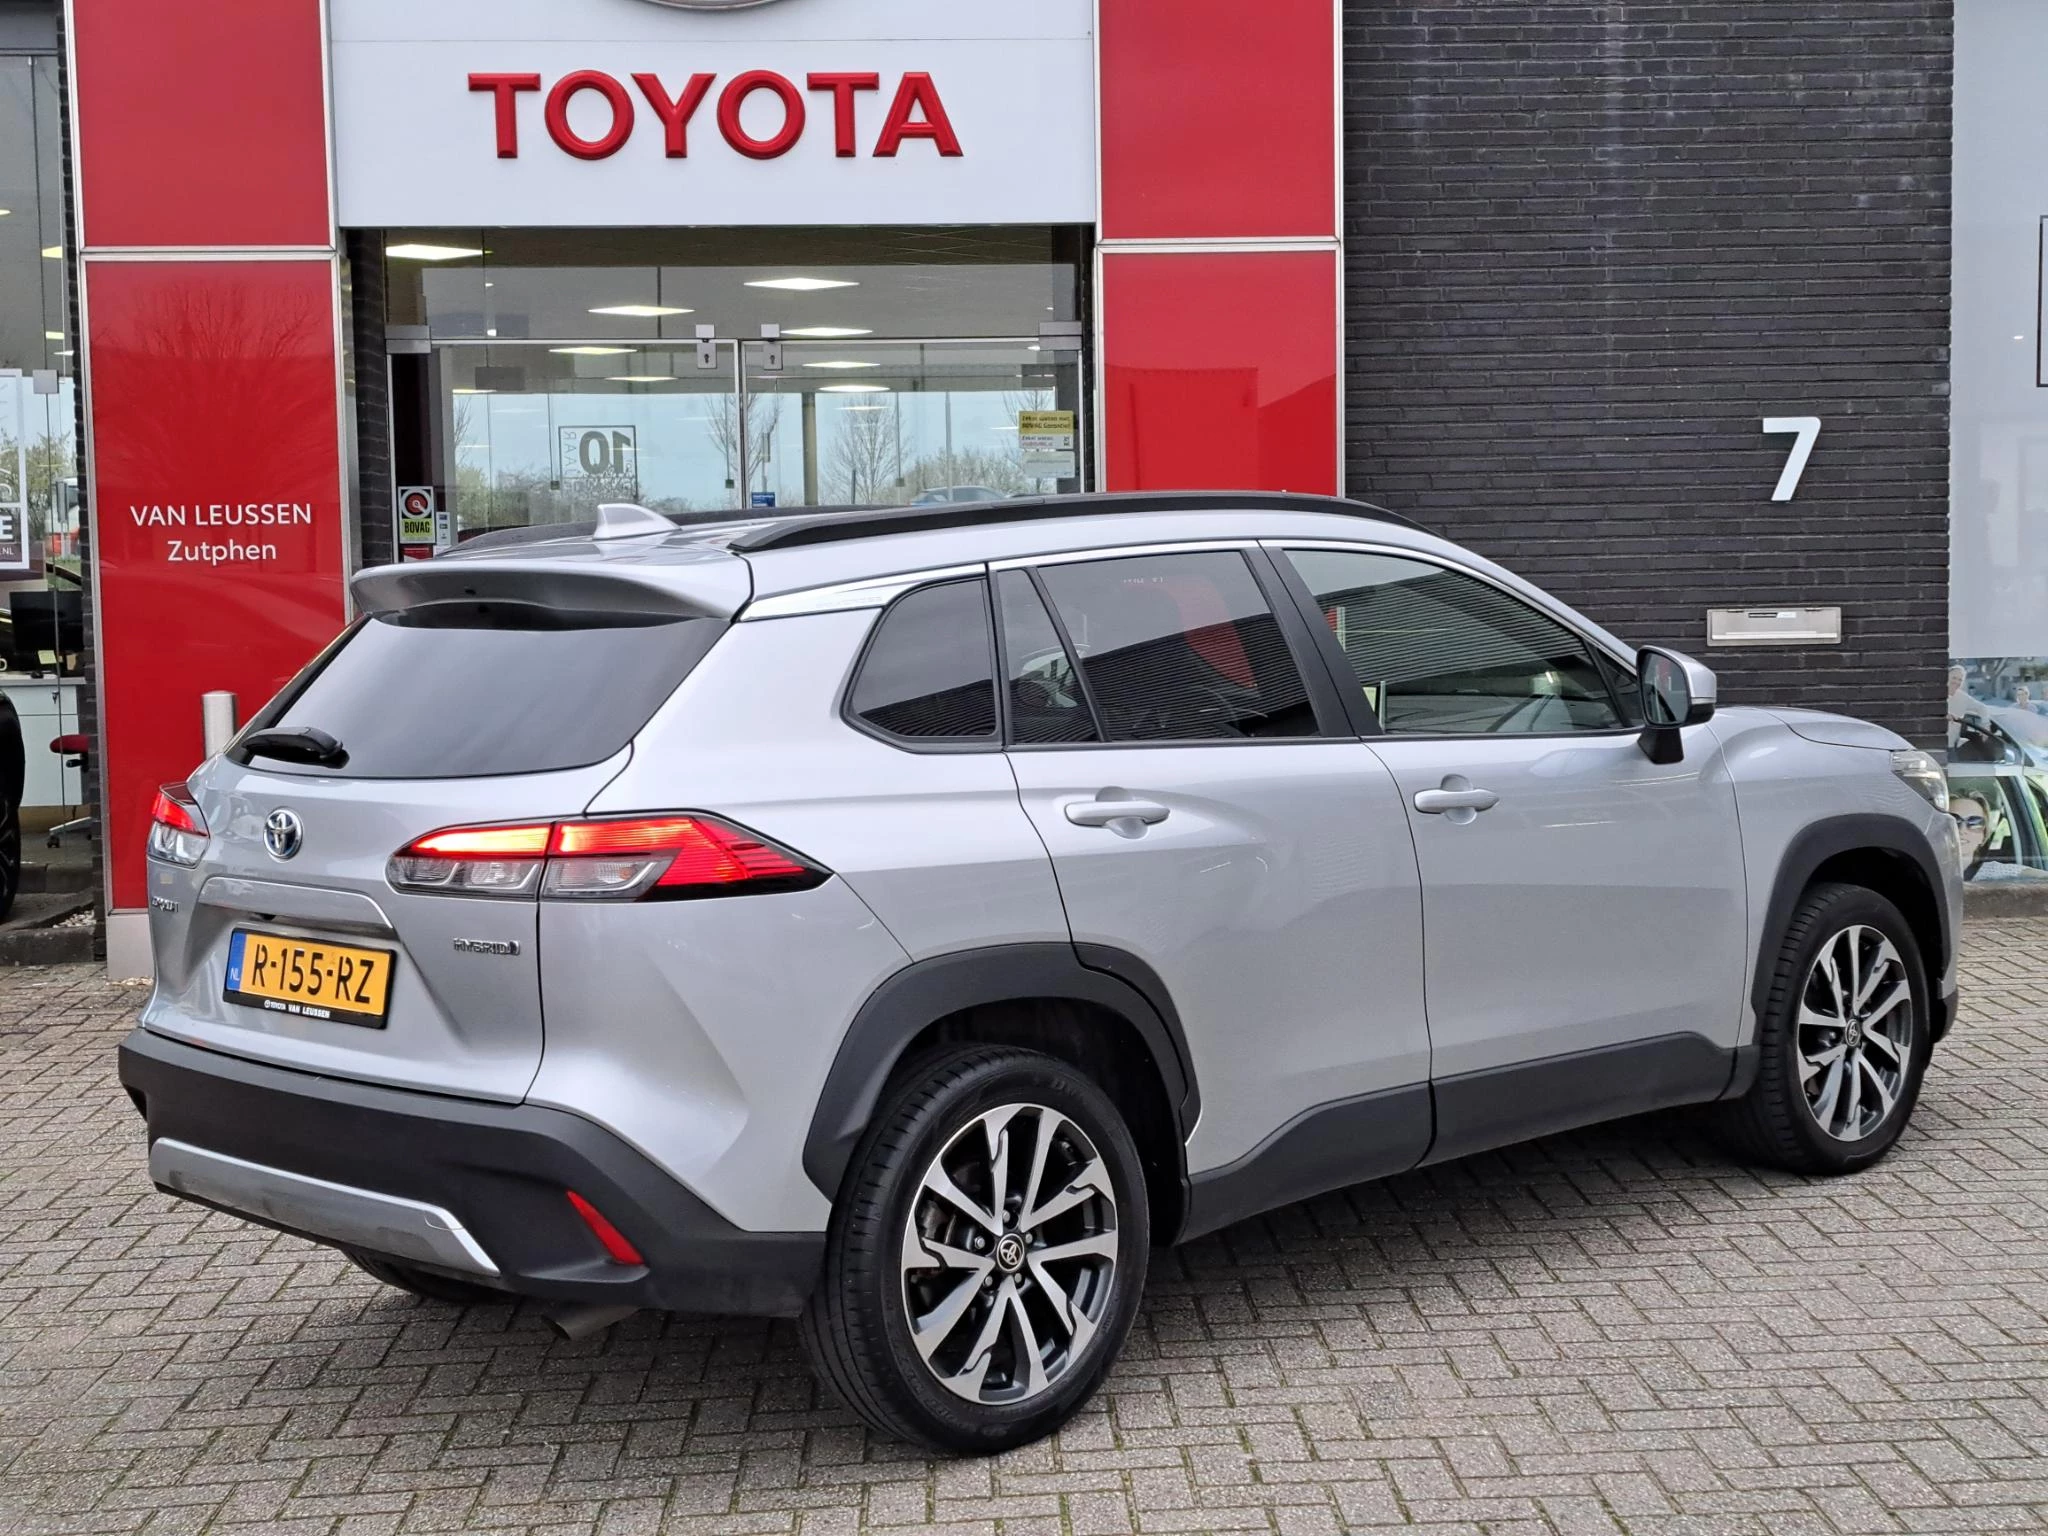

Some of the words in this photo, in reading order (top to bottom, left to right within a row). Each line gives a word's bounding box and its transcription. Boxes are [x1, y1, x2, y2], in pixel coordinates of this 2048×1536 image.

[468, 69, 963, 160] TOYOTA
[1762, 416, 1821, 502] 7
[130, 505, 186, 526] VAN
[195, 504, 311, 525] LEUSSEN
[404, 521, 430, 534] BOVAG
[167, 539, 277, 566] Zutphen
[453, 937, 508, 955] HYBRID
[230, 967, 240, 981] NL
[252, 943, 374, 1004] R-155-RZ
[288, 1004, 300, 1014] VAN
[302, 1006, 331, 1019] LEUSSEN
